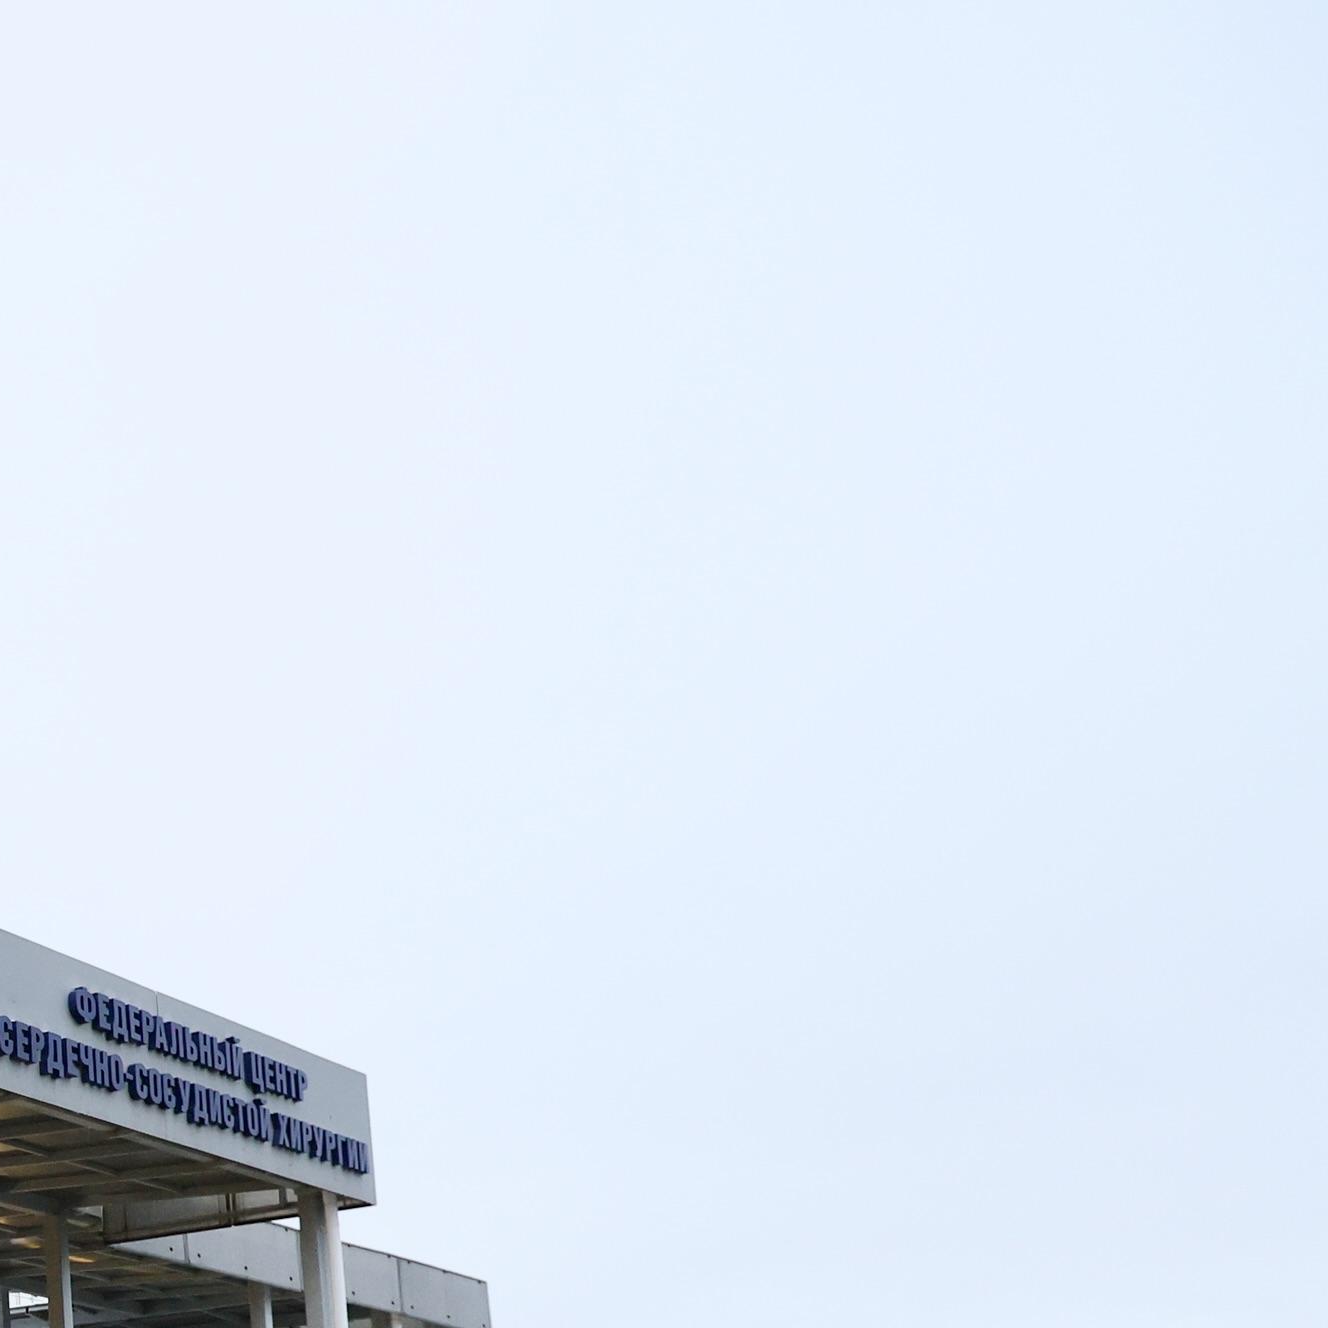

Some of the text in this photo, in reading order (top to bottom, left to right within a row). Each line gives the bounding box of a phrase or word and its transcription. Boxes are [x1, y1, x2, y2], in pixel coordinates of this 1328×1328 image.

[68, 986, 308, 1102] ФЕДЕРАЛЬНЫЙ ЦЕНТР
[271, 1112, 370, 1174] ХИРУРГИИ
